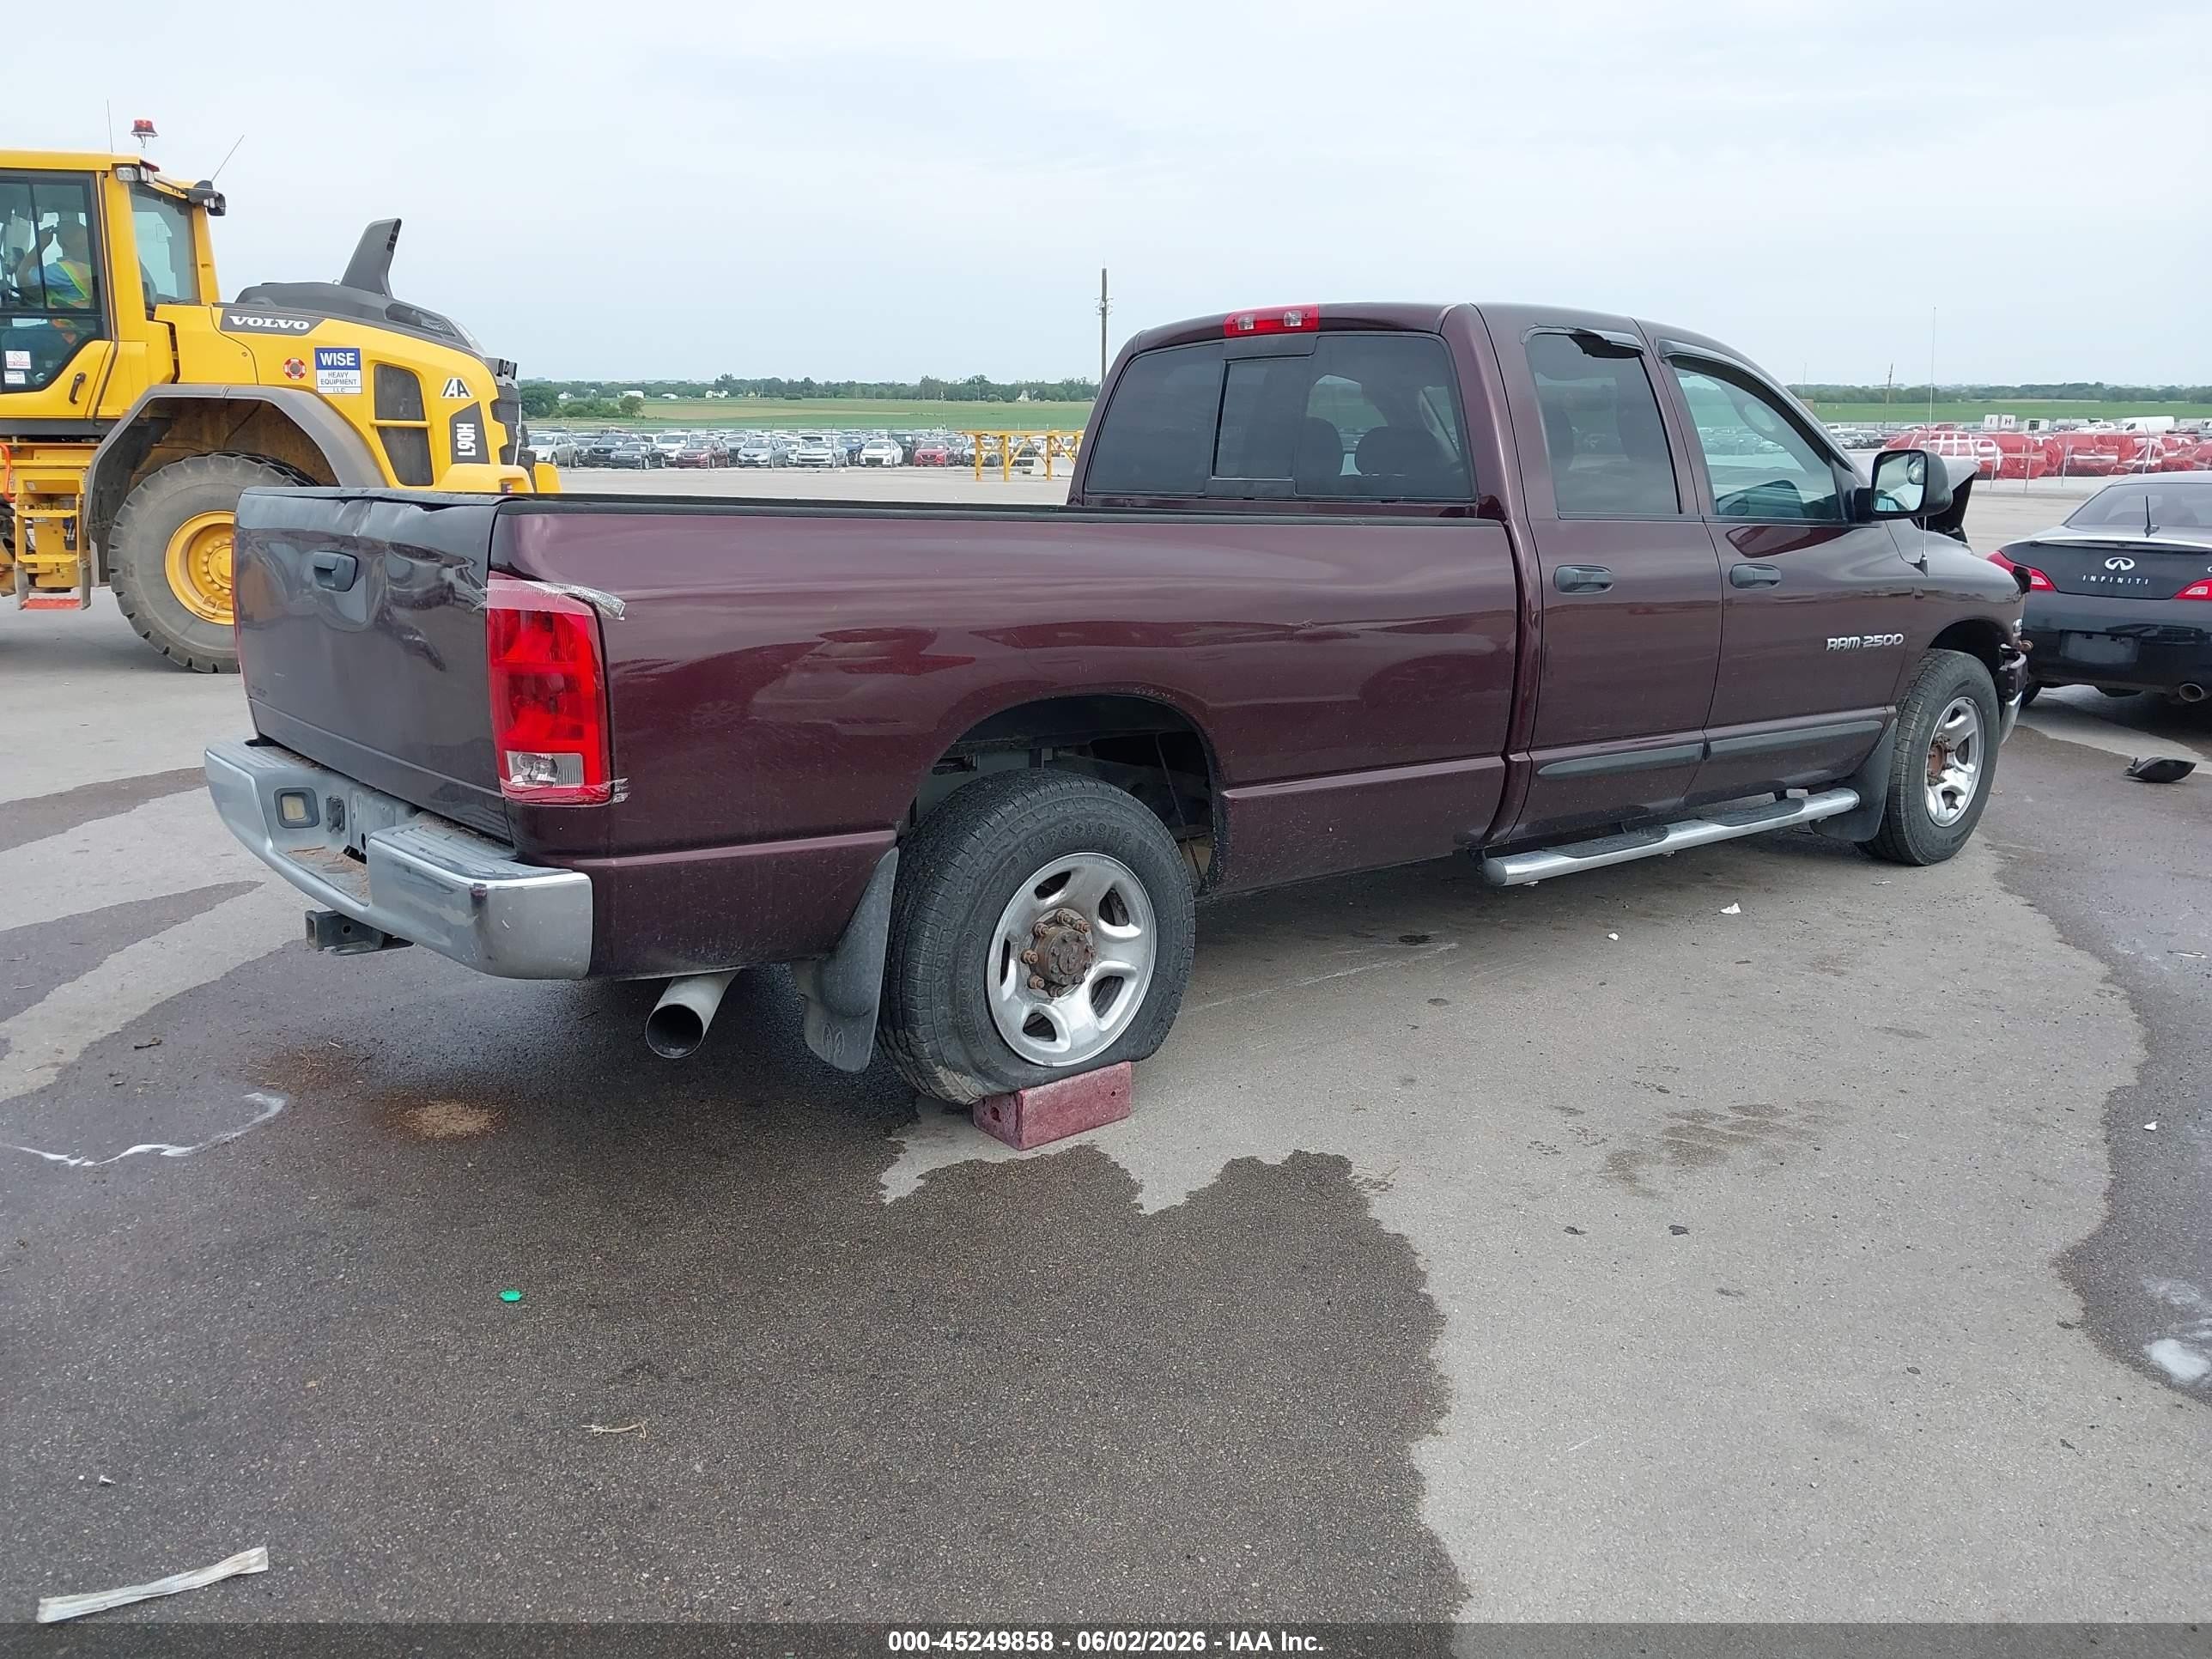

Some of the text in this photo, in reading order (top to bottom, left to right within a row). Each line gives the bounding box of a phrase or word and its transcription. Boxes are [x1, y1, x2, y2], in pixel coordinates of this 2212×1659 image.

[228, 315, 310, 330] VOLVO
[319, 352, 356, 366] WISE
[456, 422, 477, 457] L90H
[2082, 574, 2148, 586] INFINITI
[1826, 633, 1904, 652] RAM 2500
